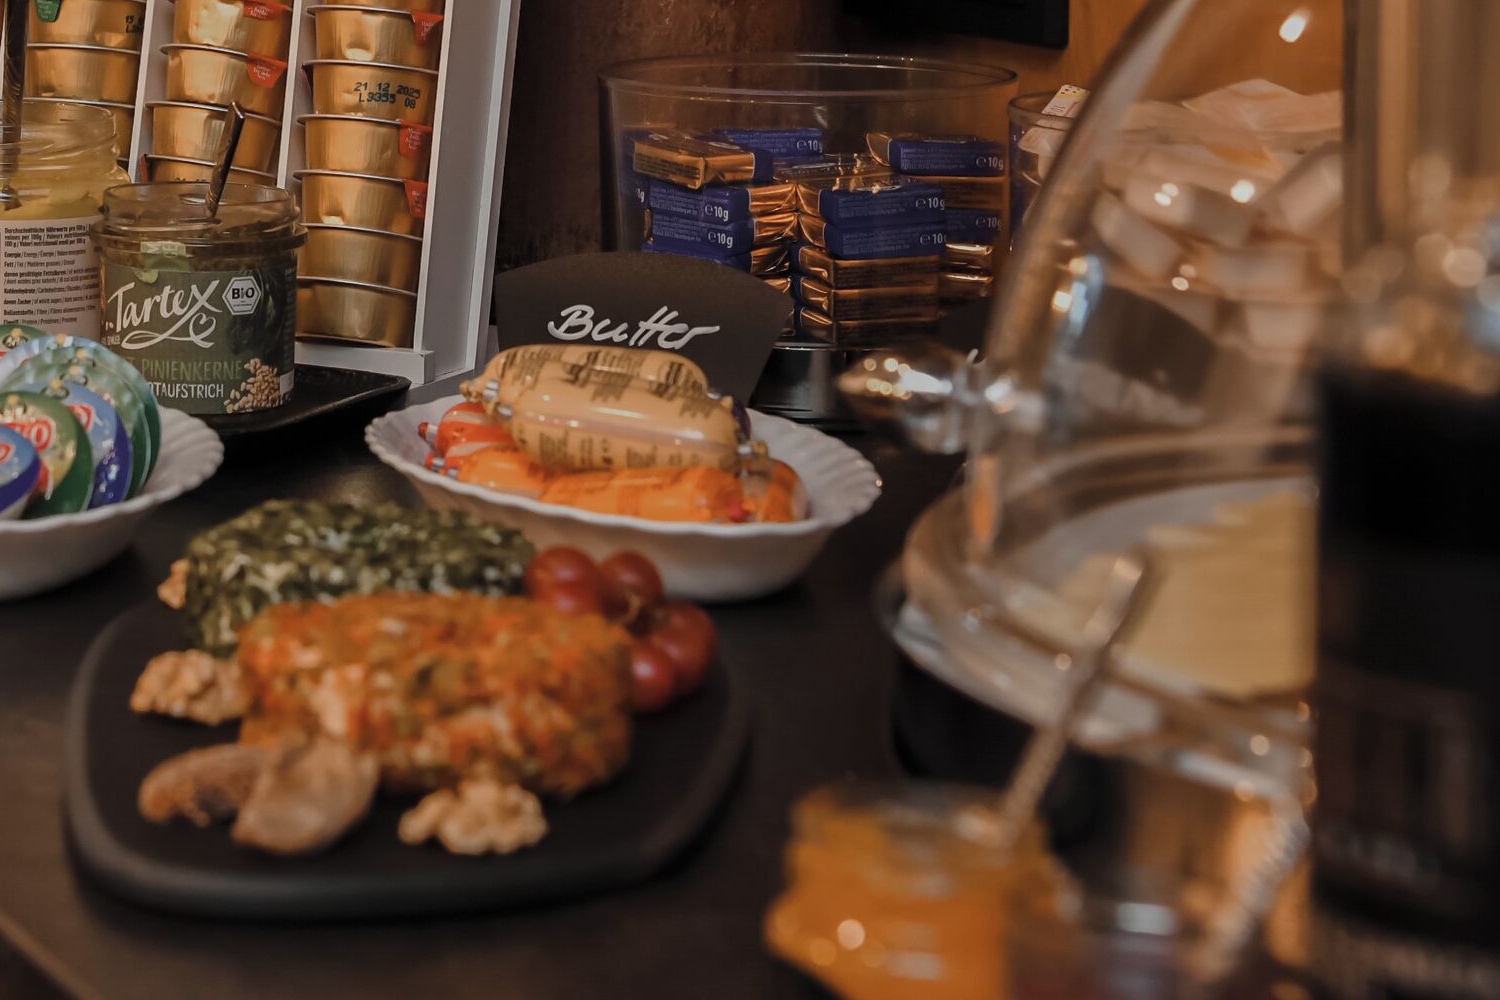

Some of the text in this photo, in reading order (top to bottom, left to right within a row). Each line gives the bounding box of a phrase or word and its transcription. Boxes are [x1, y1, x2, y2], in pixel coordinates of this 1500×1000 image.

[354, 82, 421, 99] 21 12 2025
[404, 98, 416, 109] 08
[988, 156, 1004, 170] 10g
[928, 197, 946, 211] 10g
[714, 205, 729, 221] 10g
[717, 232, 733, 248] 10g
[107, 279, 223, 333] Tartex
[547, 304, 720, 350] Butter
[141, 359, 242, 380] PINIENKERNE
